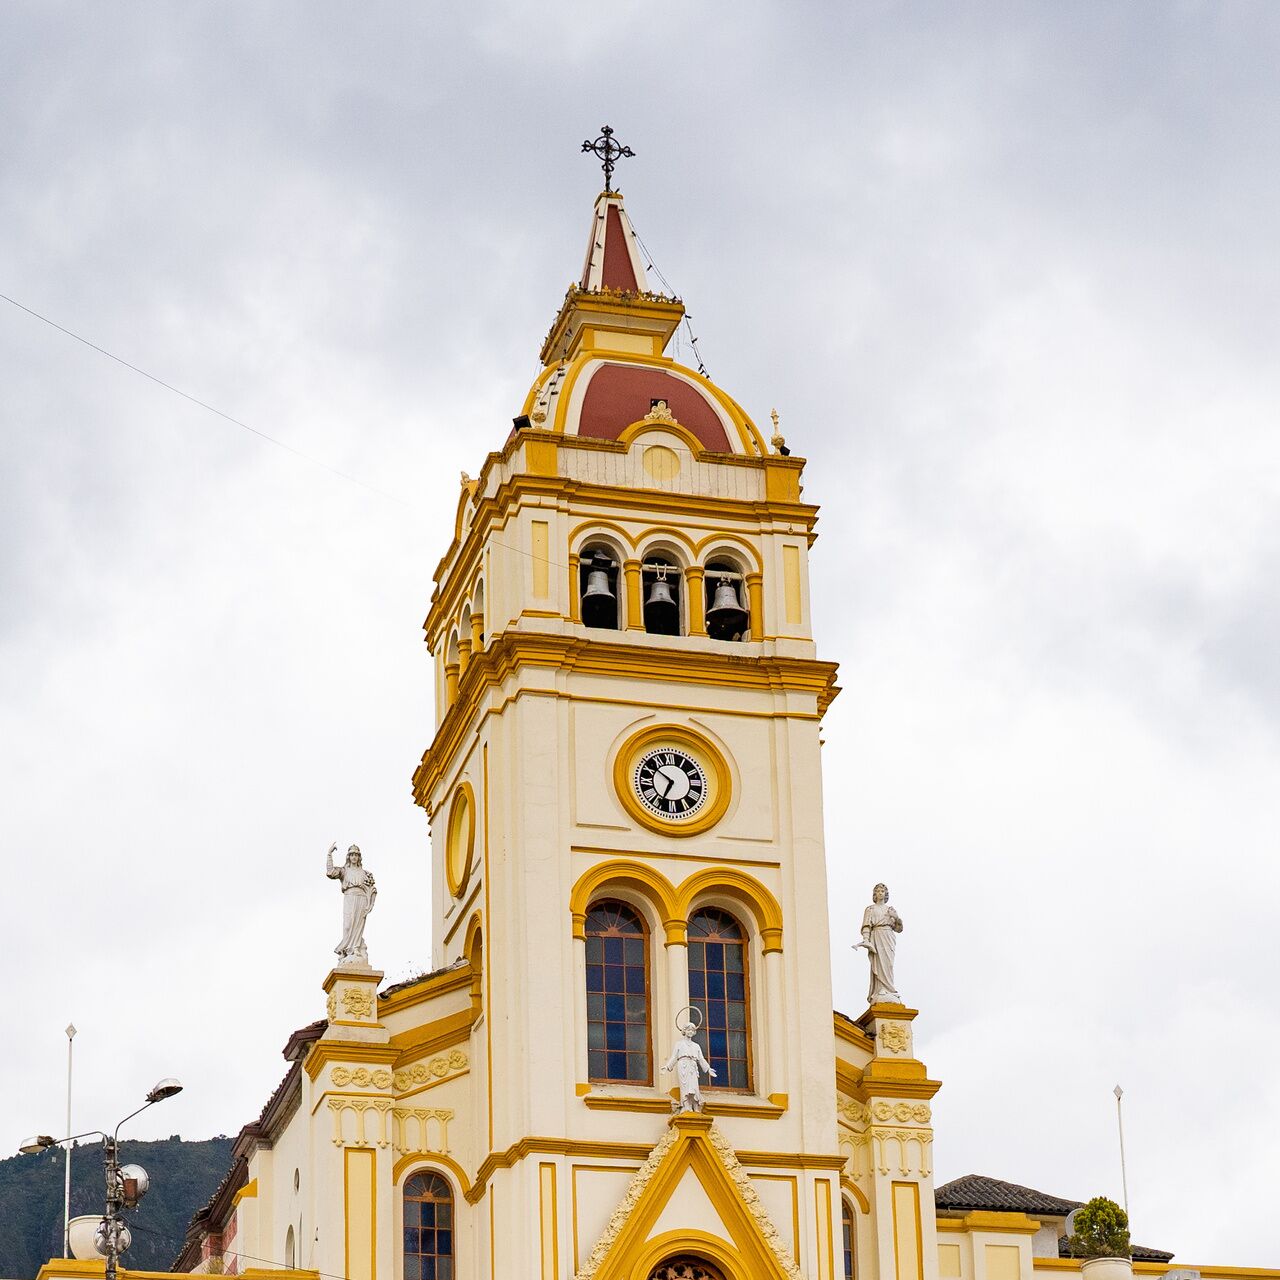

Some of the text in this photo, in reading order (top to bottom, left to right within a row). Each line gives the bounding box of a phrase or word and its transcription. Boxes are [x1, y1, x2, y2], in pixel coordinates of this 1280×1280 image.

[652, 755, 664, 768] XI
[665, 754, 676, 765] XII
[679, 759, 685, 768] I
[642, 765, 655, 775] X
[668, 800, 677, 812] VI
